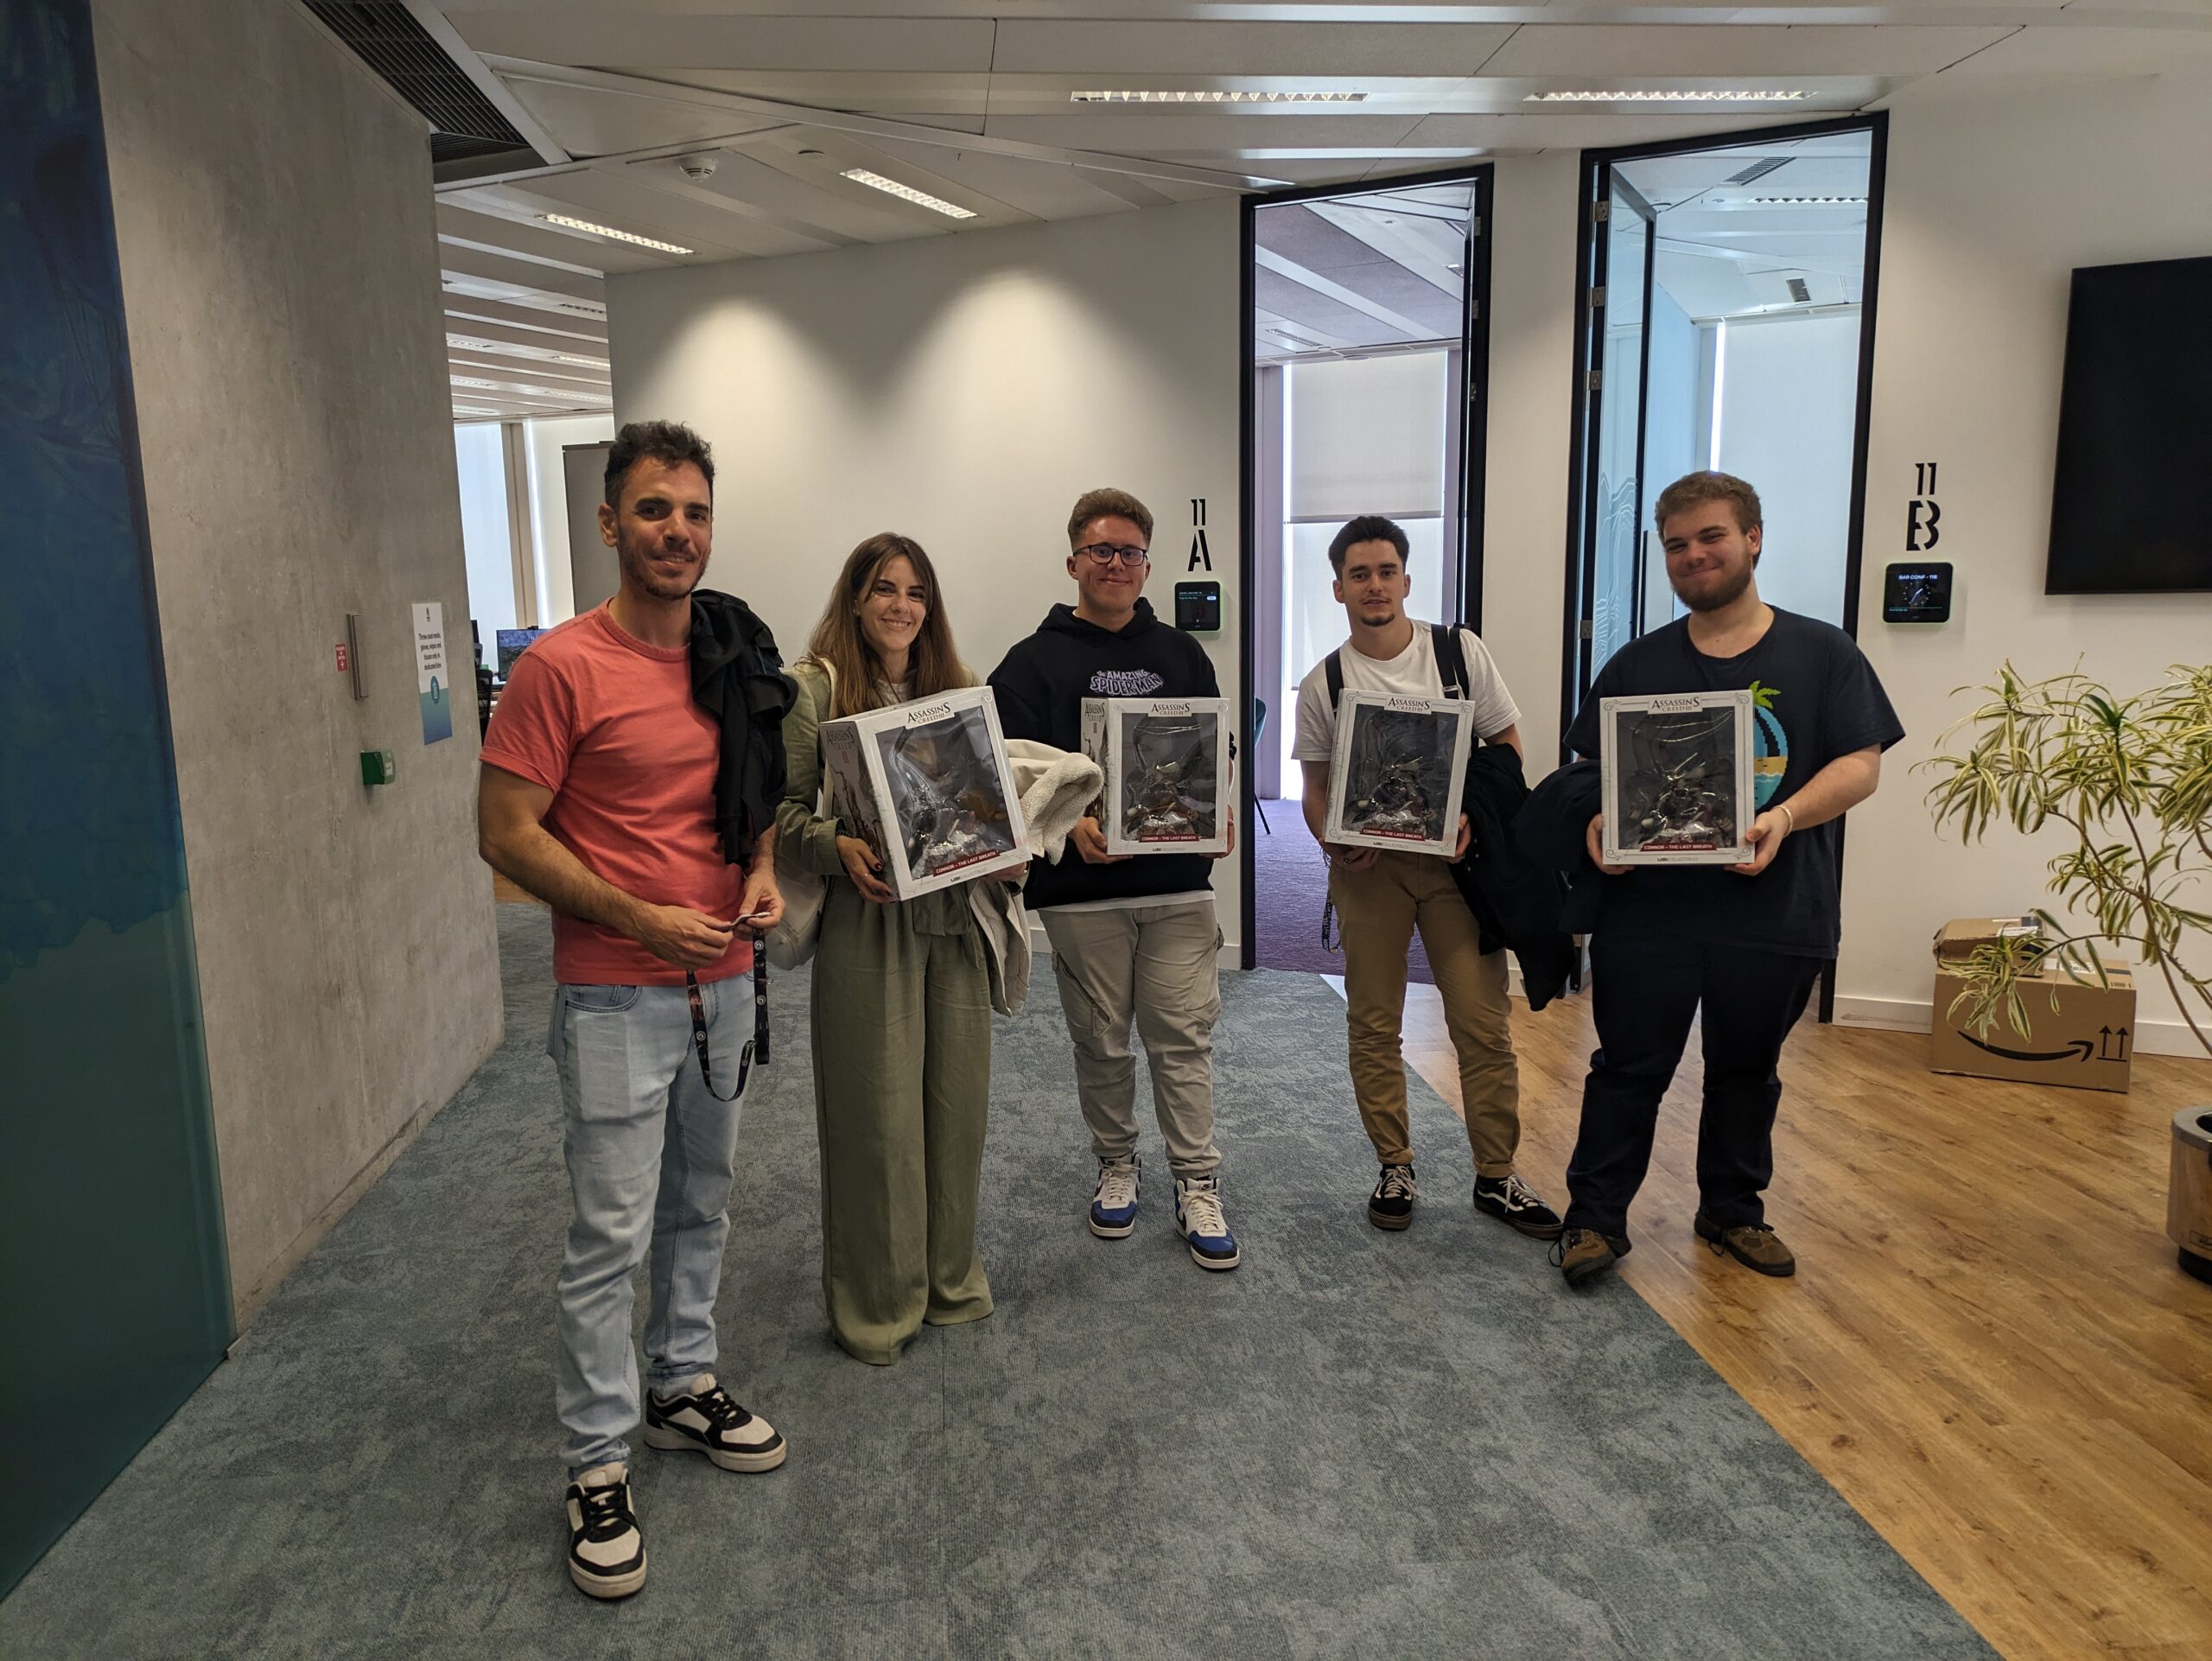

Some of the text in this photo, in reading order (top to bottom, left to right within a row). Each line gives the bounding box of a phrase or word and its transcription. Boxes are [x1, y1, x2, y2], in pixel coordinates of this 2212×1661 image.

[1915, 462, 1937, 495] 11
[1191, 499, 1205, 525] 11
[1906, 500, 1941, 551] B
[1188, 530, 1211, 571] A
[1107, 669, 1149, 681] AMAZING
